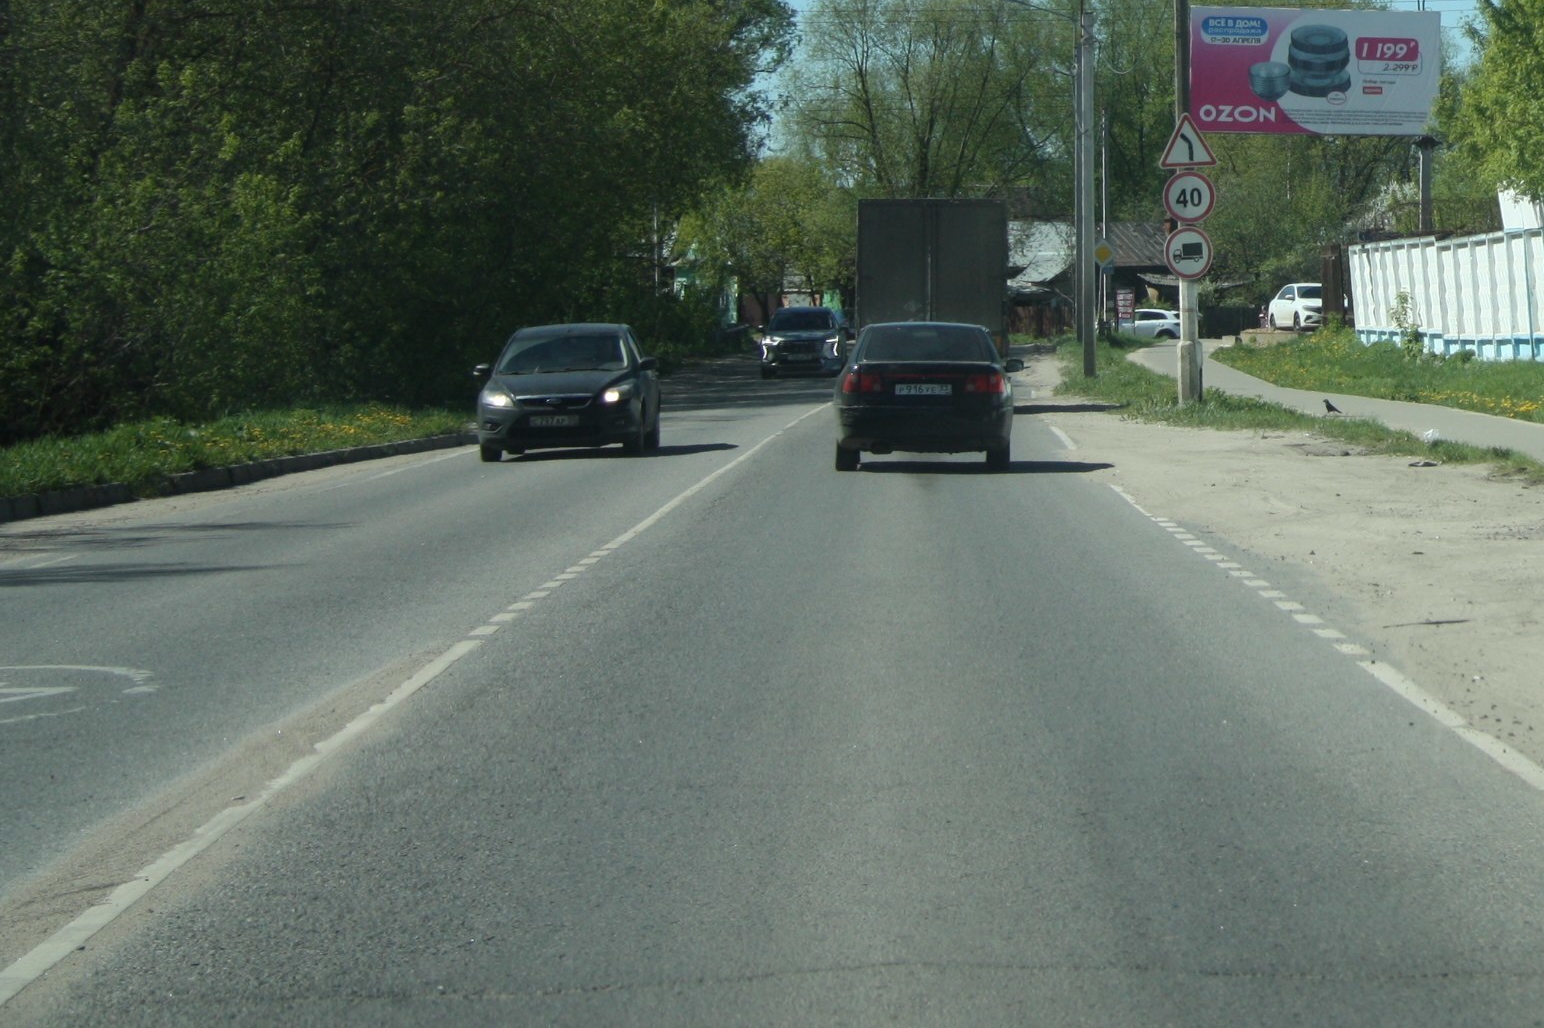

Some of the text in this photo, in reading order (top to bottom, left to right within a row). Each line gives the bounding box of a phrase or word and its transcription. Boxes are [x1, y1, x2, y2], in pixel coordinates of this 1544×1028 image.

[1208, 18, 1226, 27] ВСЁ
[1235, 19, 1261, 28] ДОМ!
[1199, 104, 1276, 123] OZON
[1175, 187, 1203, 208] 40
